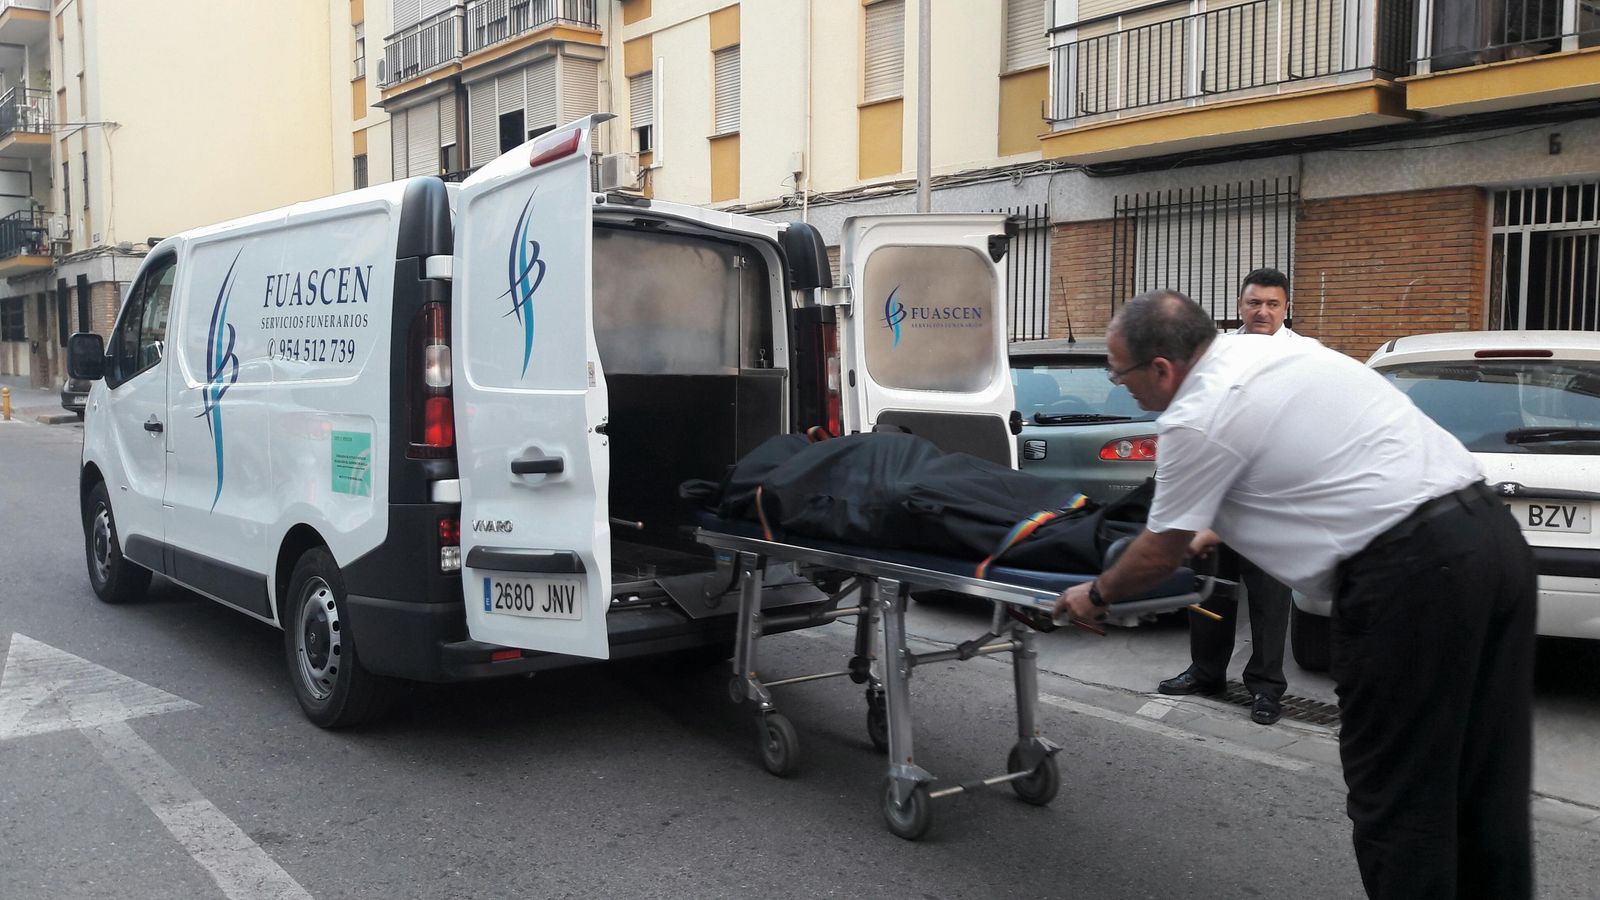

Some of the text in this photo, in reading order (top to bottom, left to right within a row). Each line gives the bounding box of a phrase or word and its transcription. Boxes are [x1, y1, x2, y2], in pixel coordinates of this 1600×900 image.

[263, 265, 373, 308] FUASCEN
[261, 313, 369, 330] SERVICIOS FUNERARIOS
[911, 307, 982, 320] FUASCEN
[279, 338, 355, 363] 954 512 739
[472, 520, 513, 533] VIVARO
[1528, 504, 1577, 528] BZV
[495, 582, 575, 614] 2680 JNV
